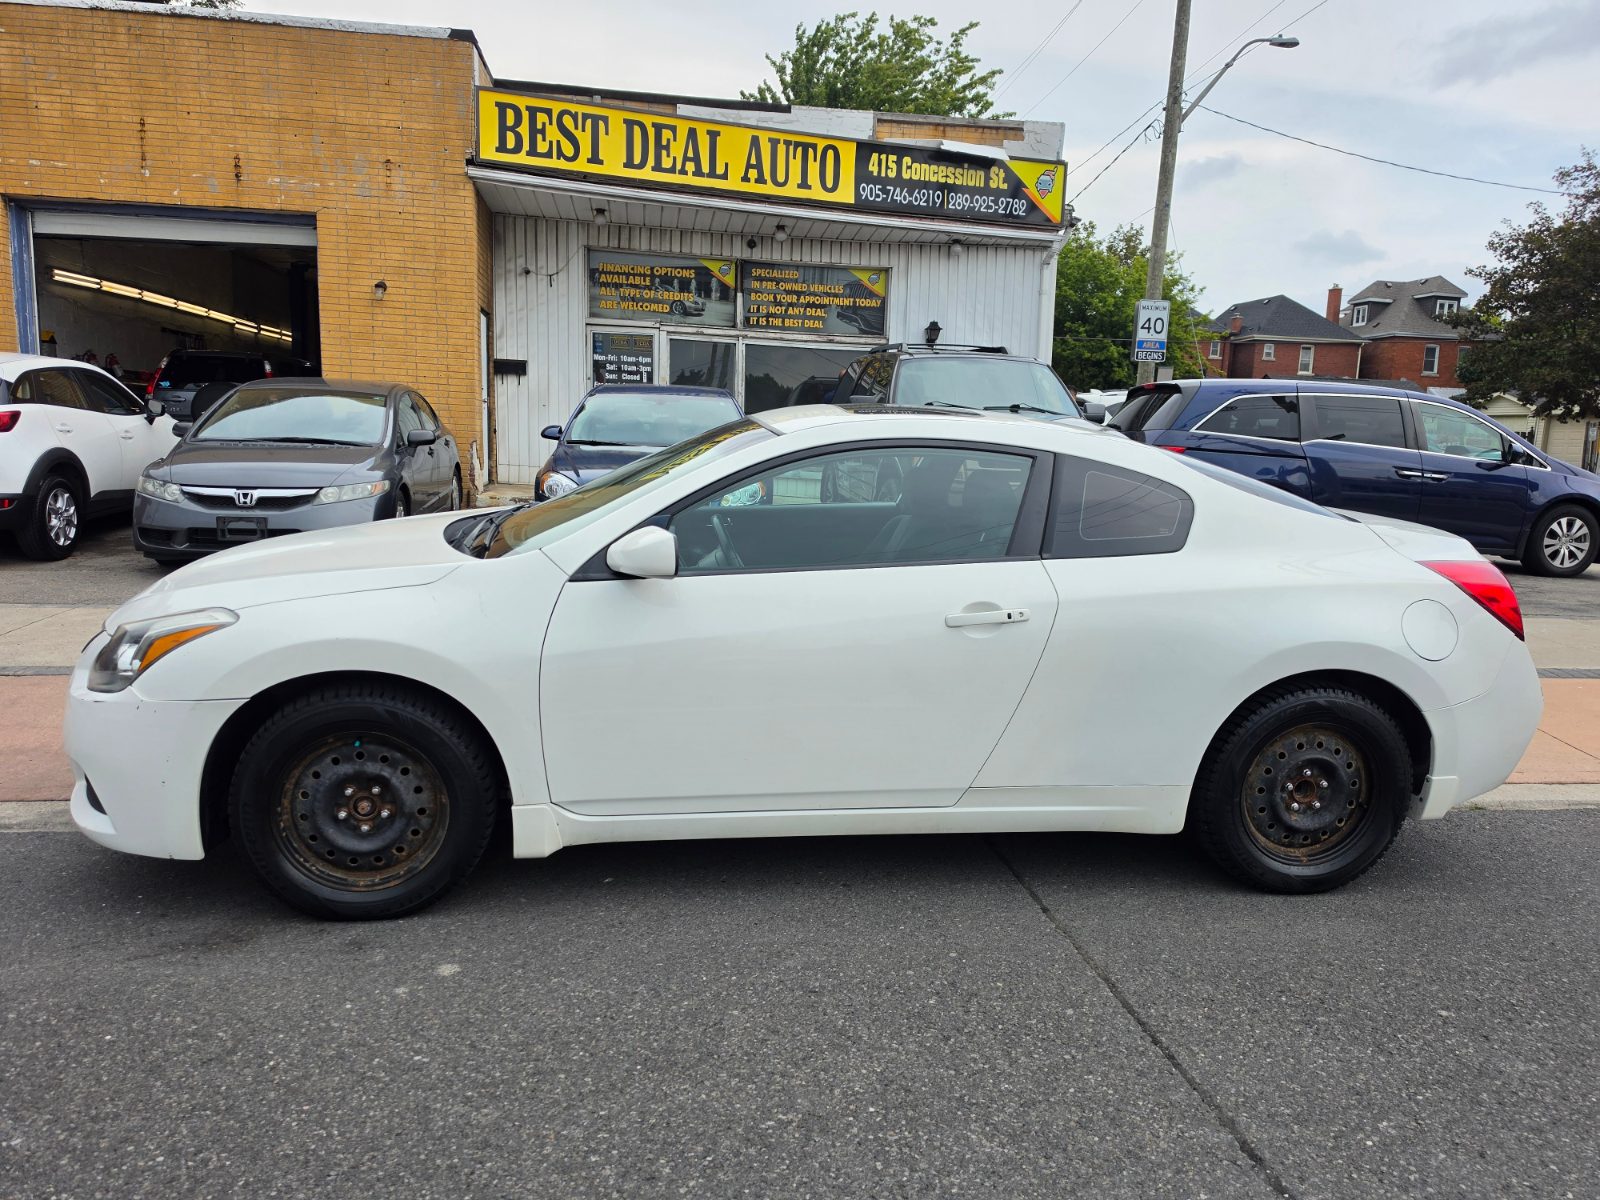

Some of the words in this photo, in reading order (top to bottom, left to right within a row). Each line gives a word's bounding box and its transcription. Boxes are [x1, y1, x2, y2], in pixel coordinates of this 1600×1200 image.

[494, 101, 609, 165] BEST
[623, 118, 729, 181] DEAL
[741, 134, 841, 193] AUTO
[868, 152, 897, 178] 415
[902, 156, 984, 188] Concession
[989, 166, 1008, 190] St.
[859, 183, 942, 208] 905-746-6219
[599, 262, 651, 275] FINANCING
[653, 266, 695, 278] OPTIONS
[751, 268, 799, 279] SPECIALIZED
[599, 274, 651, 285] AVAILABLE
[600, 286, 616, 296] ALL
[619, 288, 641, 298] TYPE
[643, 290, 655, 299] OF
[657, 290, 694, 302] CREDITS
[751, 281, 760, 289] IN
[762, 281, 807, 291] PRE-OWNED
[809, 284, 844, 294] VEHICLES
[599, 300, 618, 309] ARE
[620, 301, 670, 313] WELCOMED
[750, 292, 774, 302] BOOK
[776, 293, 797, 303] YOUR
[799, 295, 854, 306] APPOINTMENT
[855, 298, 882, 308] TODAY
[750, 305, 758, 313] IT
[759, 305, 767, 313] IS
[769, 306, 785, 314] NOT
[787, 307, 804, 316] ANY
[806, 308, 828, 318] DEAL,
[750, 317, 756, 325] IT
[759, 317, 767, 325] IS
[769, 318, 782, 326] THE
[784, 318, 803, 327] BEST
[804, 319, 823, 328] DEAL
[1140, 317, 1165, 334] 40
[1142, 341, 1160, 349] AREA
[593, 353, 618, 361] Mon-Fri:
[620, 355, 652, 363] 10am-6pm
[1138, 351, 1163, 360] BEGINS
[621, 373, 640, 381] Closed
